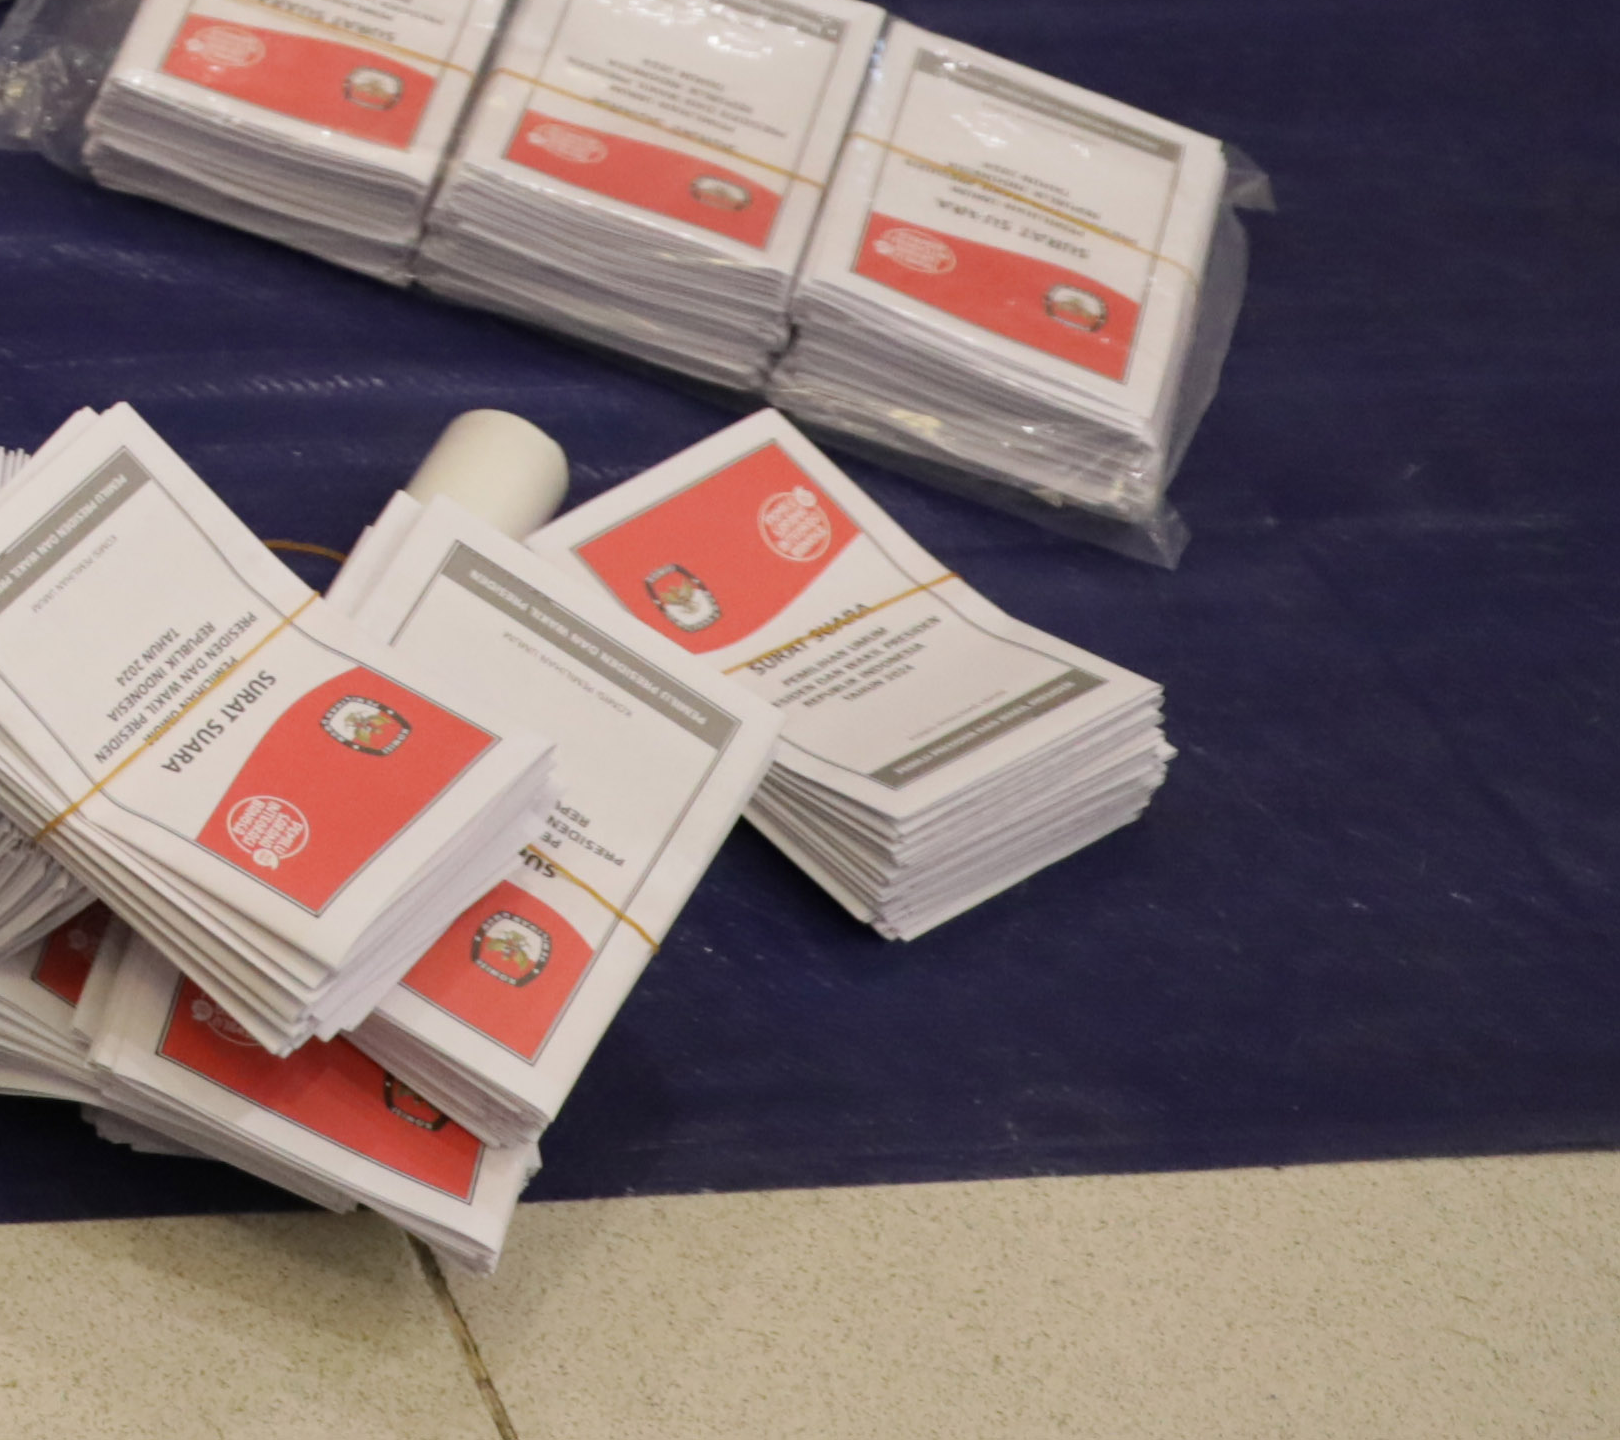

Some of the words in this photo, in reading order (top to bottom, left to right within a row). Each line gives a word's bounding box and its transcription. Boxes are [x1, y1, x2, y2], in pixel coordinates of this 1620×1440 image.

[92, 471, 127, 505] PEMILU
[54, 498, 98, 538] PRESIDEN
[36, 533, 59, 555] DAN
[9, 549, 41, 579] WAKIL
[140, 625, 180, 663] TAHUN
[163, 620, 217, 670] REPUBLIK
[202, 609, 258, 661] PRESIDEN
[114, 658, 145, 687] 2024
[178, 656, 208, 684] DAN
[105, 665, 168, 723] INDONESIA
[143, 679, 183, 716] WAKIL
[220, 670, 277, 724] SURAT
[92, 711, 149, 764] PRESIDEN
[161, 718, 225, 774] SUARA
